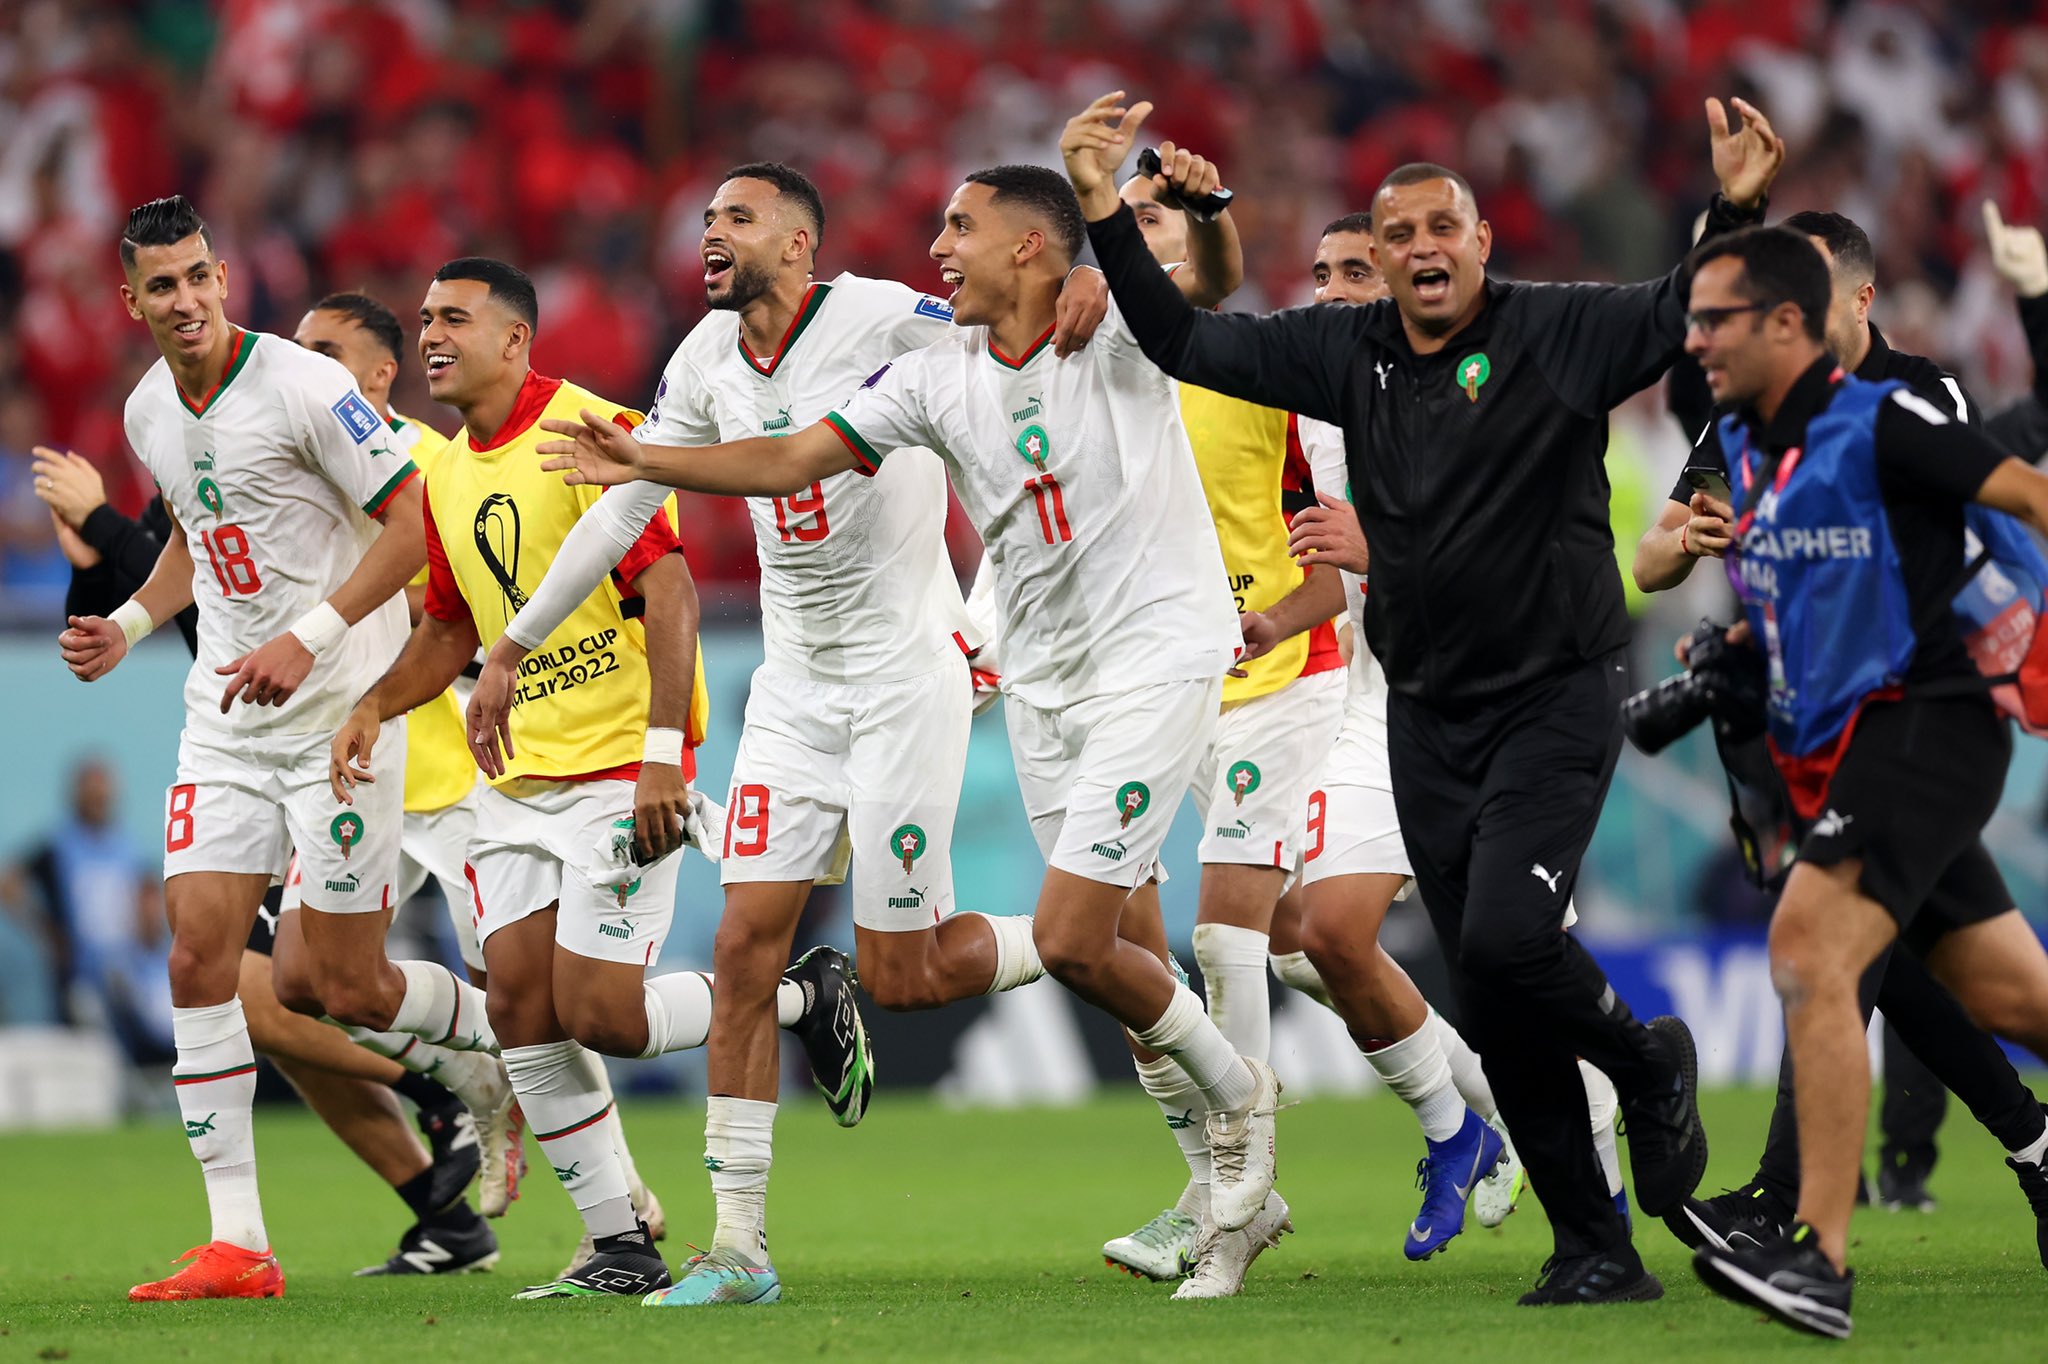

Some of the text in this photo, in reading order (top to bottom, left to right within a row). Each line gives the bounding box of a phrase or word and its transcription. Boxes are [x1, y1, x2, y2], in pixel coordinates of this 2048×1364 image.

[1012, 405, 1039, 423] PUMA
[763, 416, 790, 431] PUMA
[772, 480, 830, 541] 19
[1024, 473, 1072, 544] 11
[201, 524, 262, 597] 18
[1228, 574, 1254, 592] UP
[578, 628, 617, 655] CUP
[512, 652, 620, 711] atar2022
[722, 784, 769, 859] 19
[1216, 826, 1246, 839] PUMA
[1091, 843, 1123, 861] PUMA
[325, 880, 355, 892] PUMA
[888, 897, 920, 908] PUMA
[599, 923, 630, 939] PUMA
